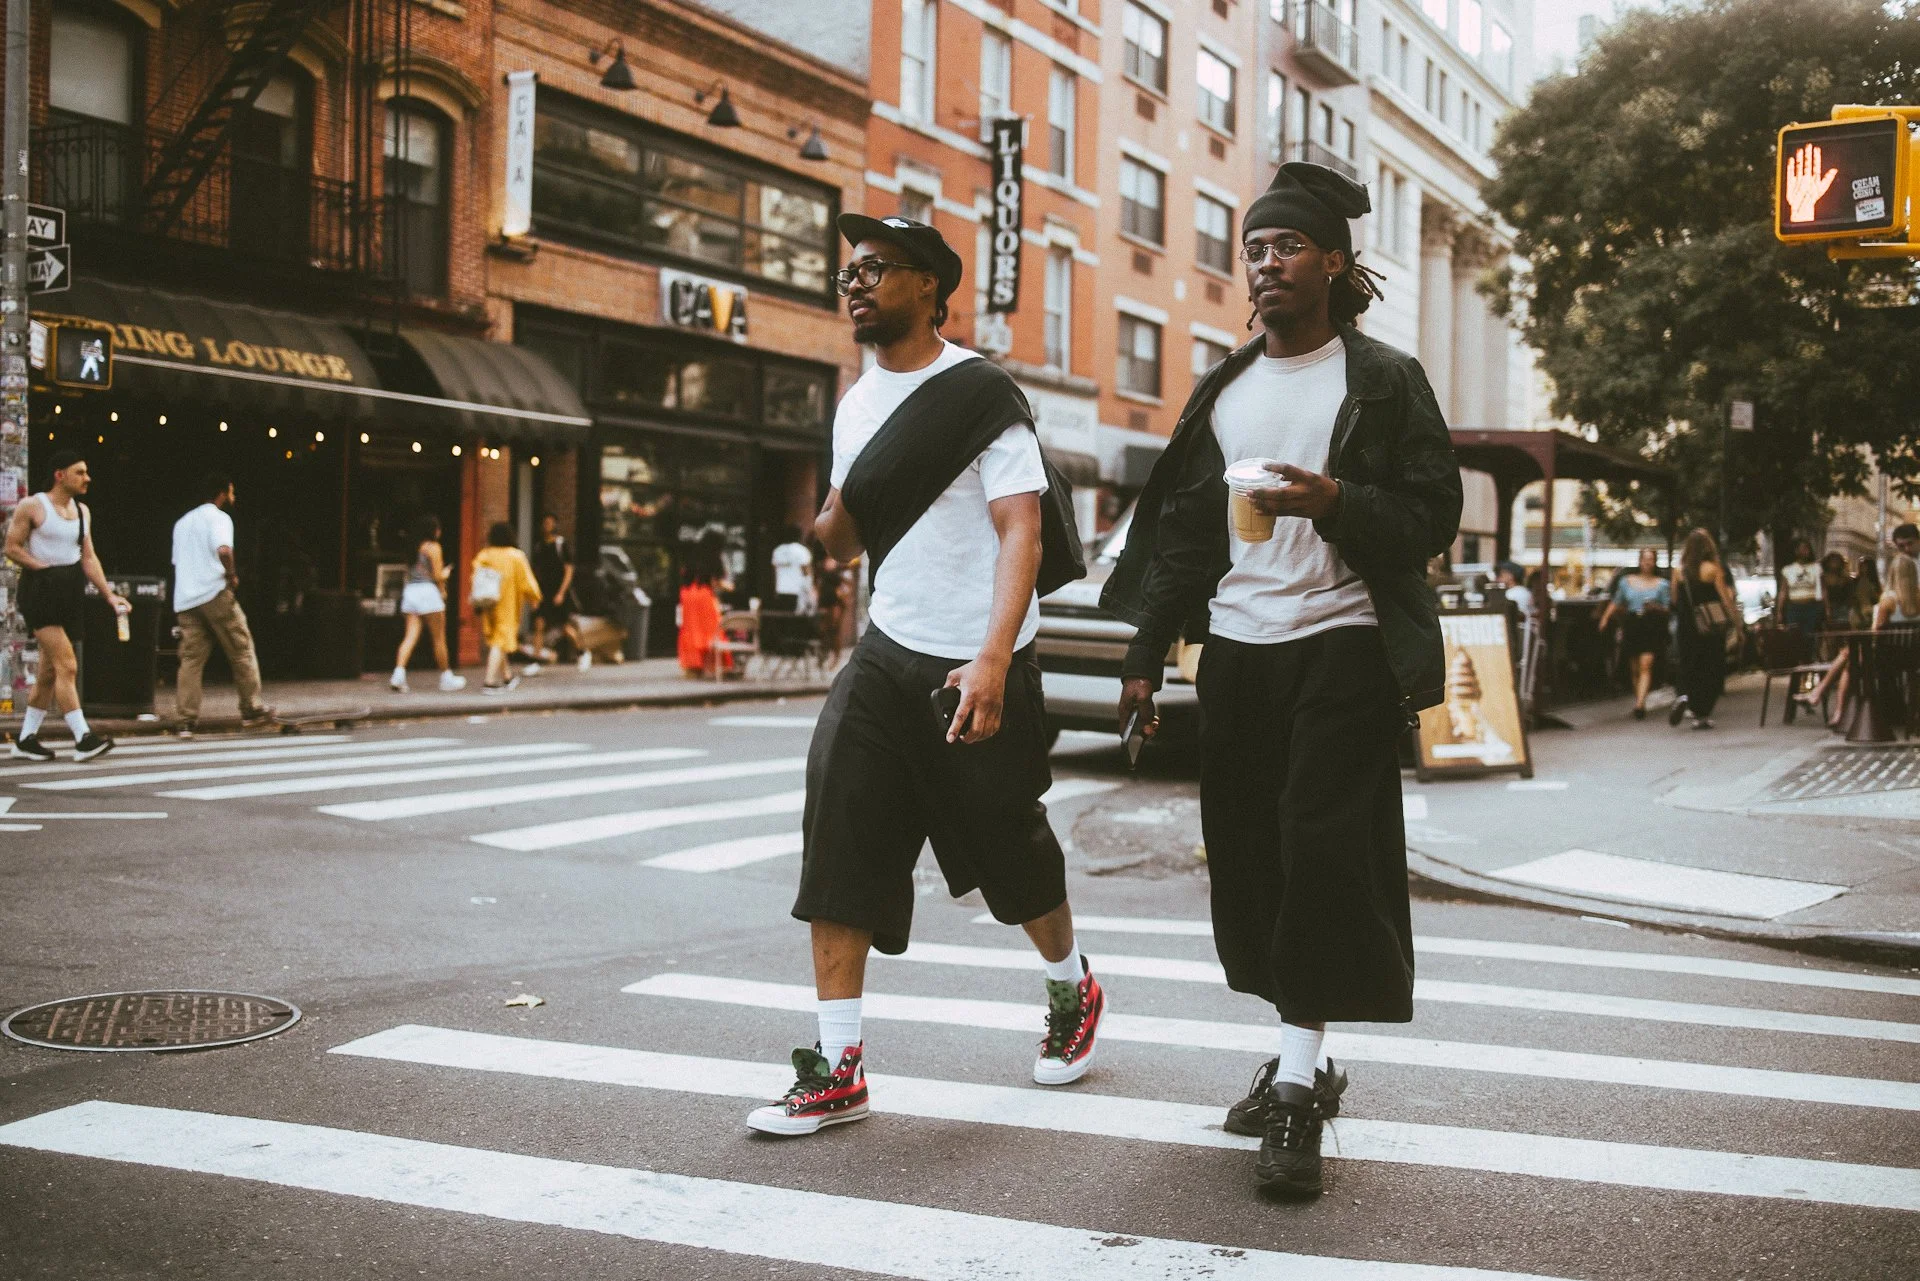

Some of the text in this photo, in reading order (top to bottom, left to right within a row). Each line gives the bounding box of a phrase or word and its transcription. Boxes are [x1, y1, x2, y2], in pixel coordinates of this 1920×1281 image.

[28, 219, 48, 235] AY
[993, 129, 1020, 305] LIQUORS
[669, 279, 749, 344] CAVA
[202, 337, 354, 381] LOUNGE
